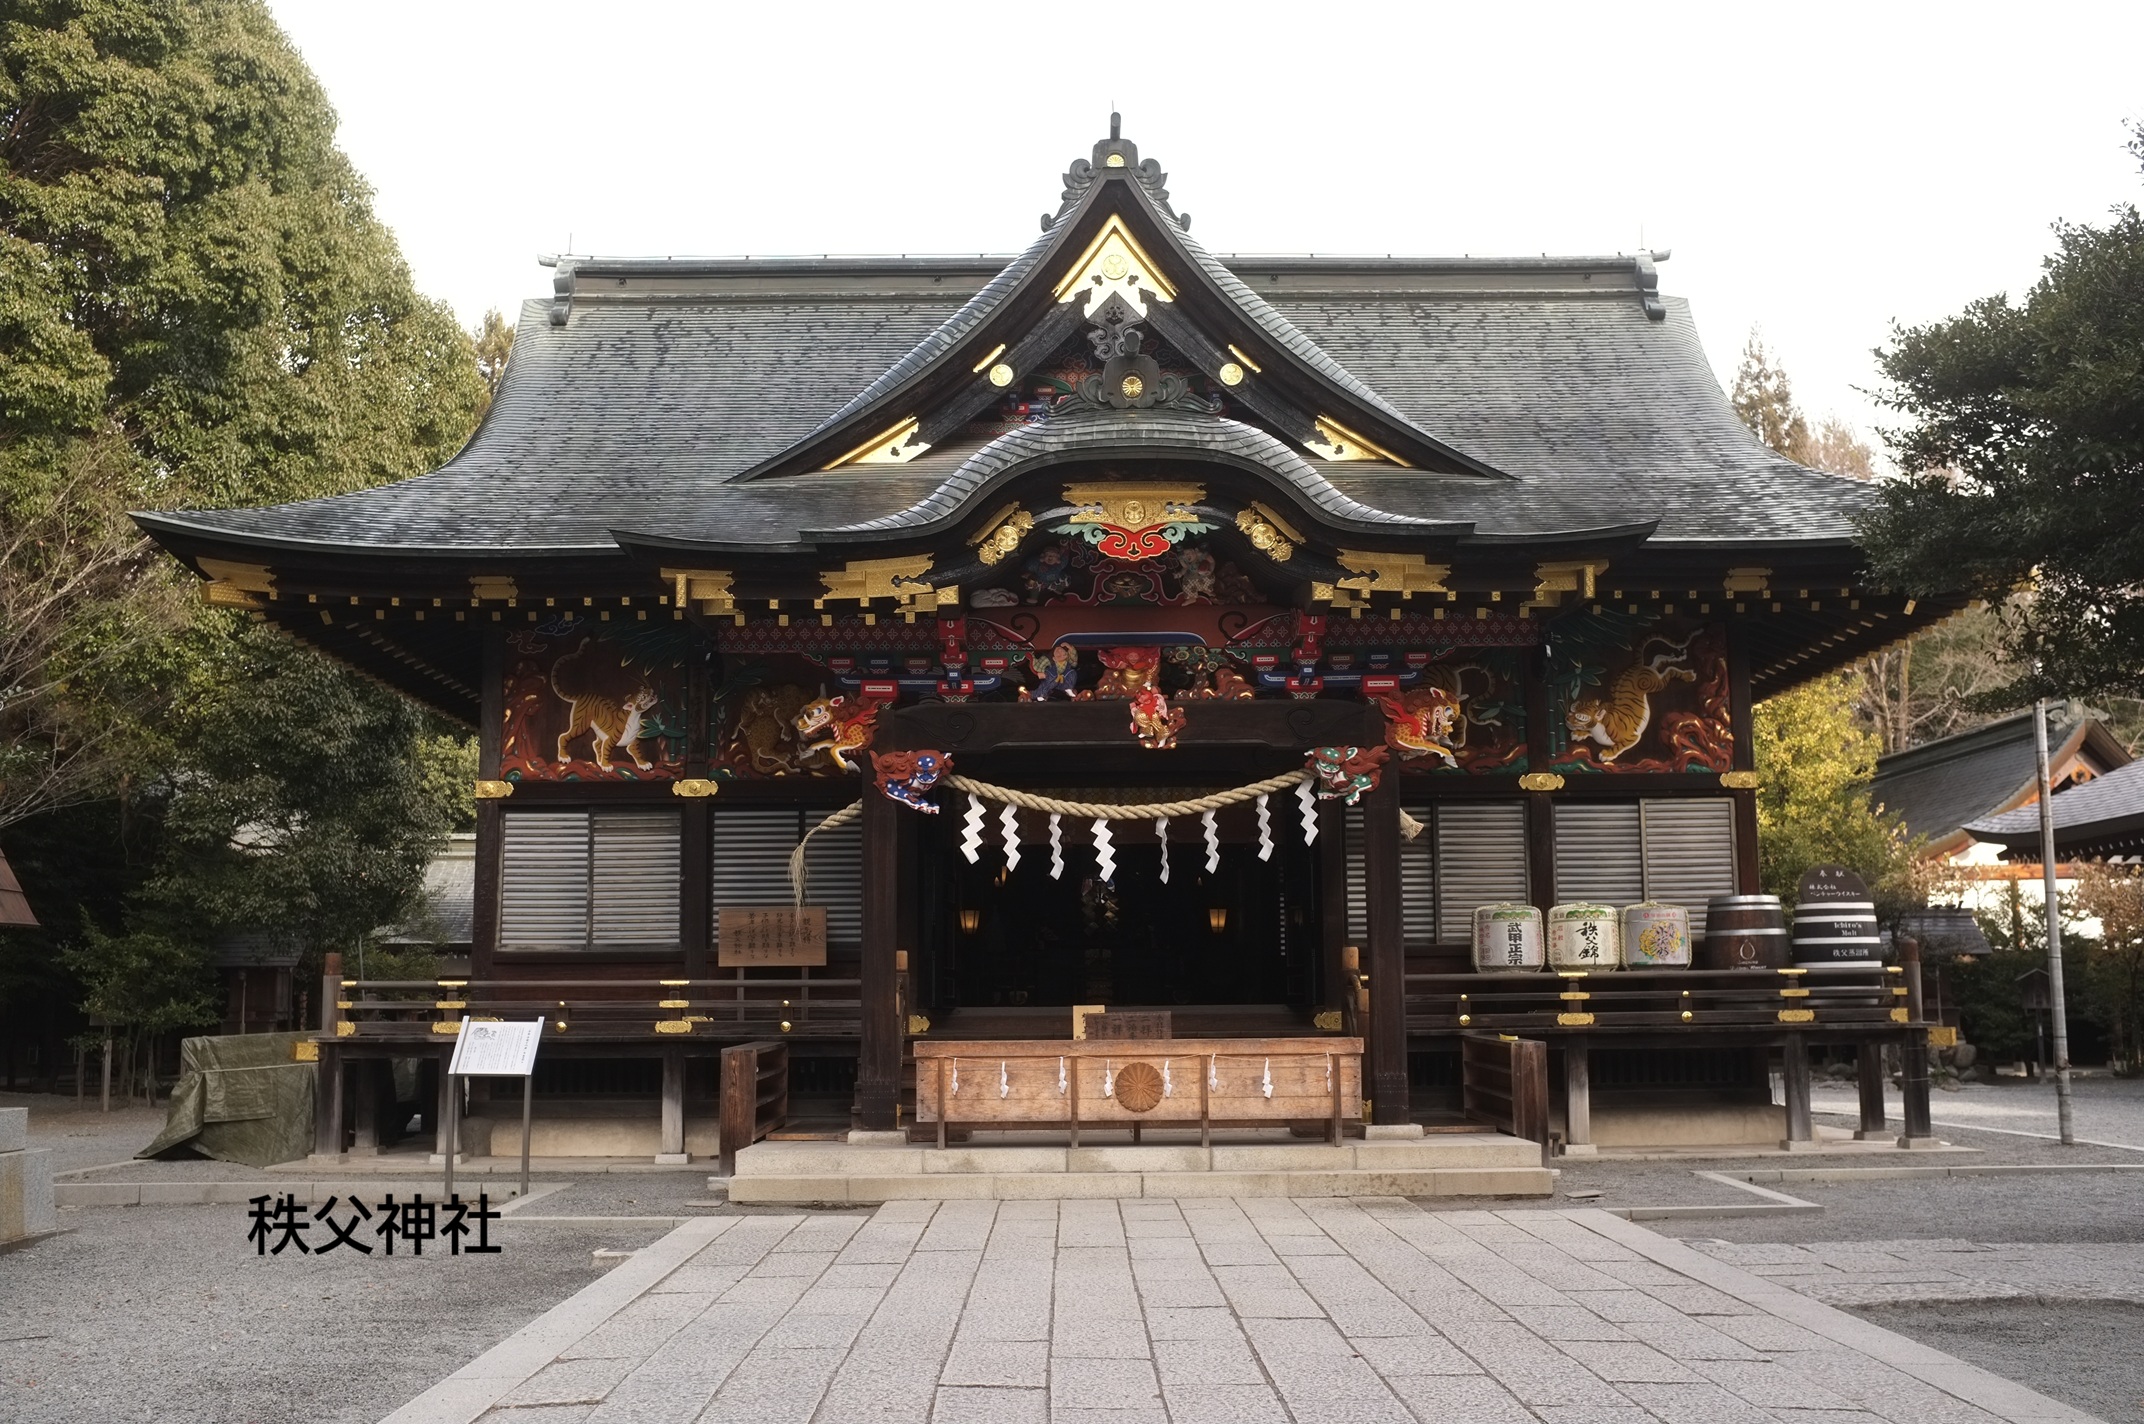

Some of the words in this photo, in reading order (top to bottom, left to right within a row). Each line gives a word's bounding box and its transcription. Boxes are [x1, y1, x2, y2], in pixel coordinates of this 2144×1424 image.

[1508, 922, 1522, 965] 武甲正宗
[1575, 921, 1599, 965] 秩父錦
